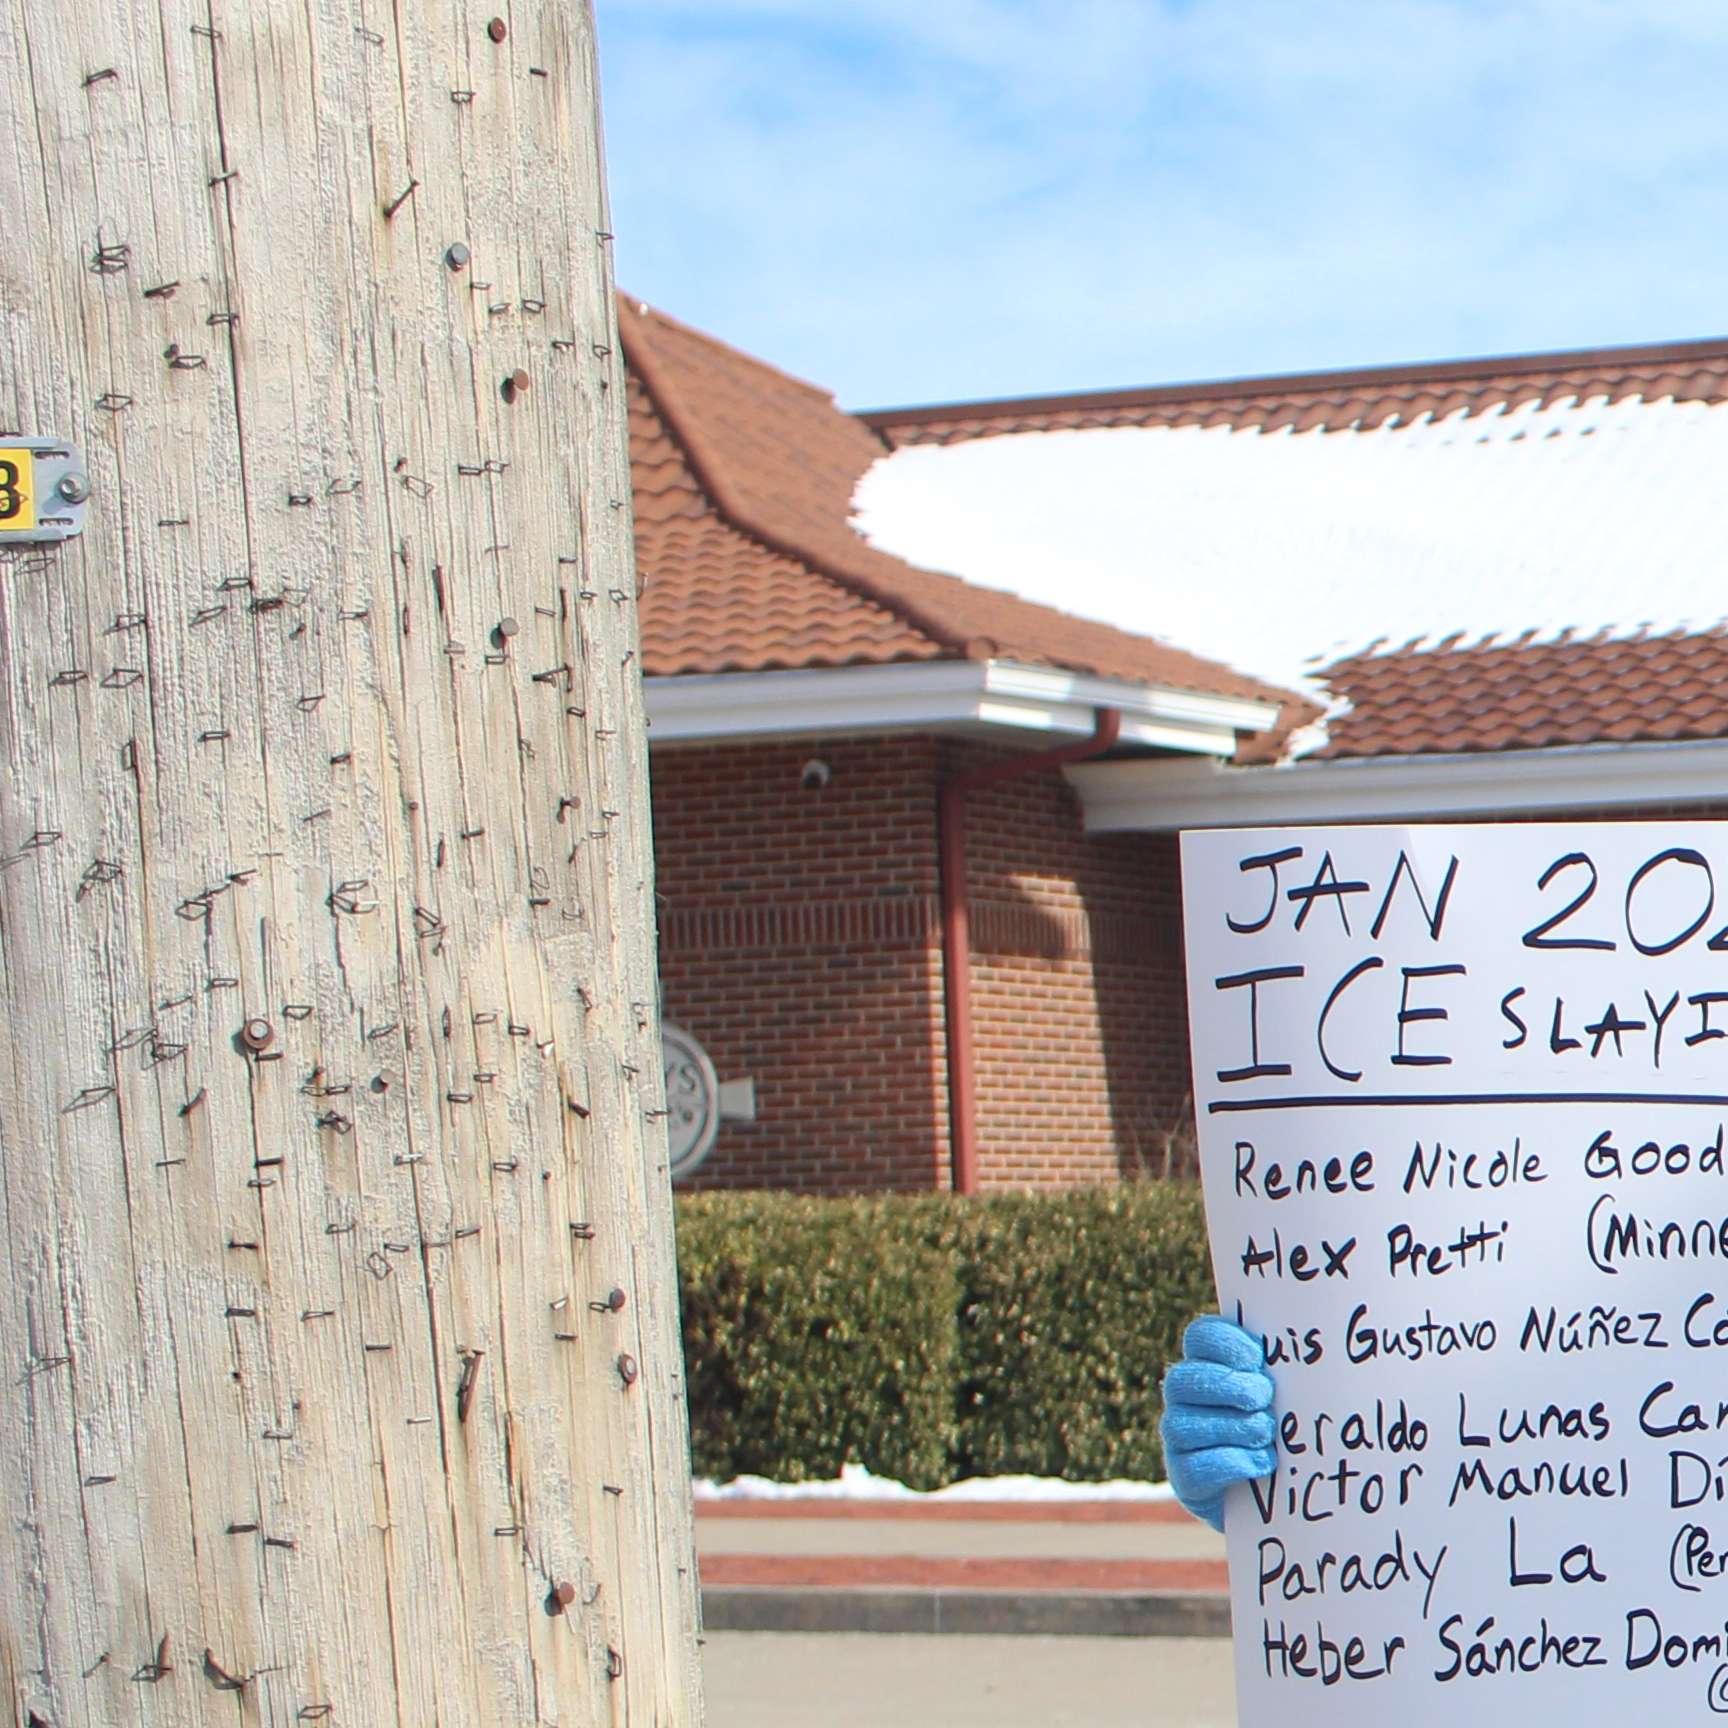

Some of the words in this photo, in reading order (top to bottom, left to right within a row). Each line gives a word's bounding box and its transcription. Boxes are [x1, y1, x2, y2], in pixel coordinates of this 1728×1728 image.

[1226, 847, 1458, 941] JAN
[1215, 957, 1466, 1083] ICE
[1235, 1142, 1374, 1200] Renee
[1403, 1138, 1547, 1194] Nicole
[1585, 1124, 1724, 1179] Good
[1241, 1228, 1356, 1281] Alex
[1387, 1221, 1508, 1277] Pretti
[1346, 1304, 1496, 1364] Gustavo
[1520, 1306, 1668, 1353] Núñez
[1278, 1400, 1427, 1456] eraldo
[1459, 1393, 1609, 1447] Lunas
[1250, 1456, 1423, 1524] Victor
[1449, 1459, 1627, 1507] Manuel
[1258, 1530, 1447, 1618] Parady
[1510, 1516, 1606, 1587] La
[1263, 1619, 1404, 1685] Heber
[1434, 1614, 1607, 1681] Sánchez
